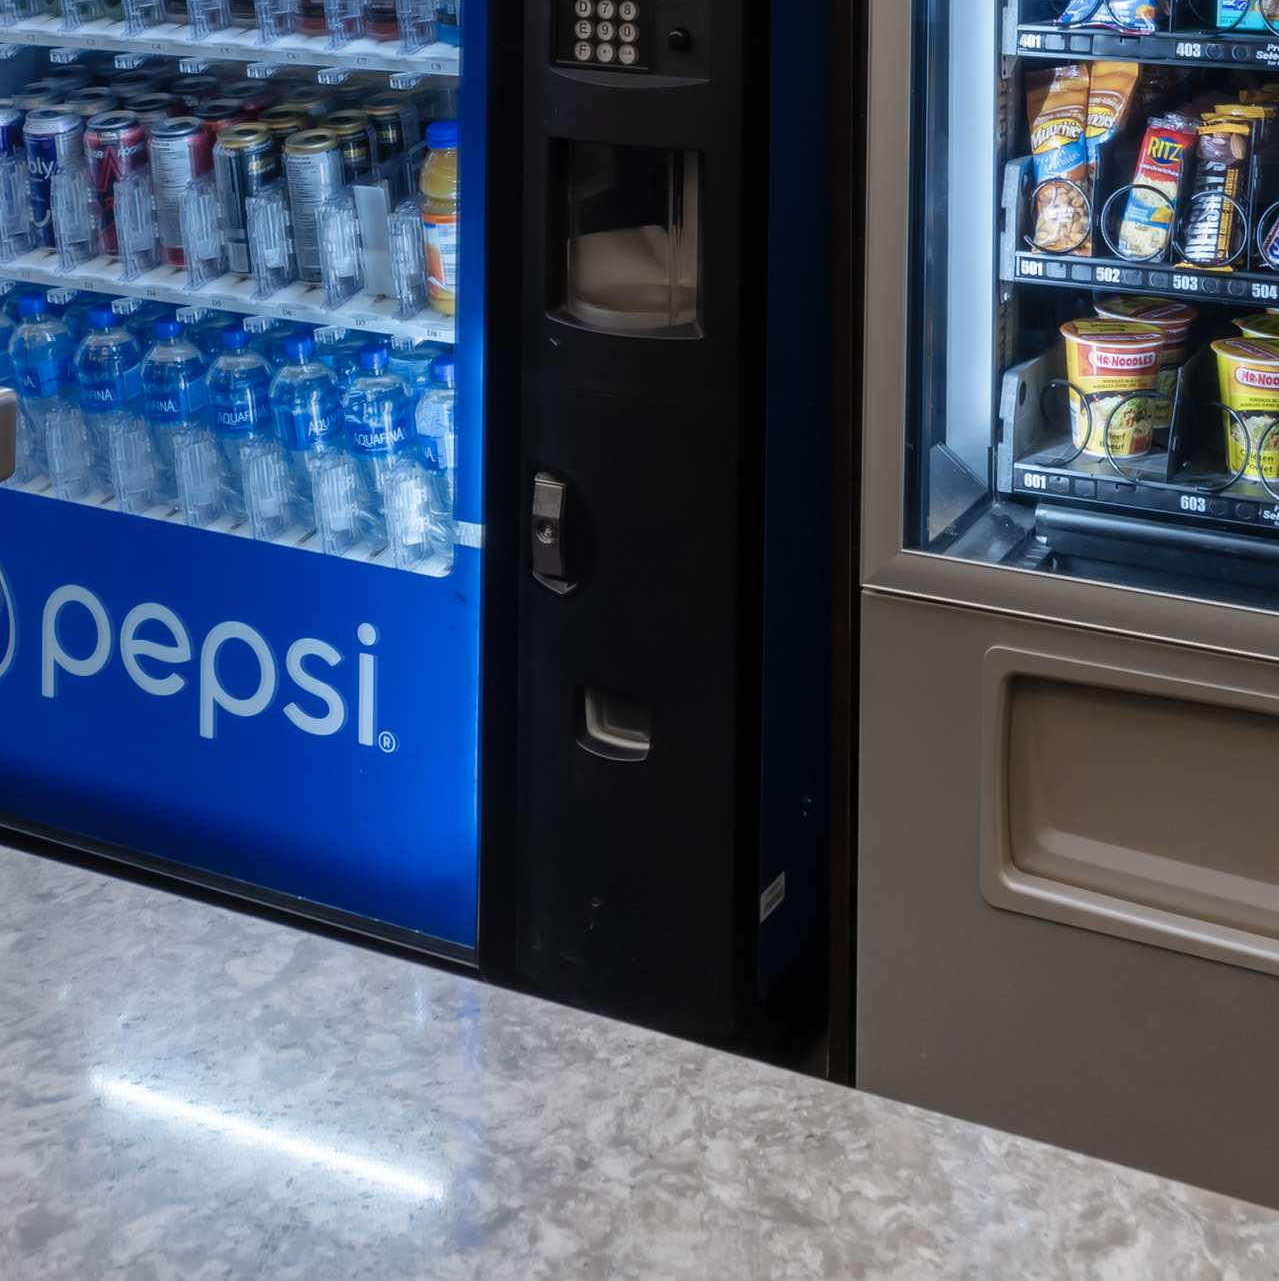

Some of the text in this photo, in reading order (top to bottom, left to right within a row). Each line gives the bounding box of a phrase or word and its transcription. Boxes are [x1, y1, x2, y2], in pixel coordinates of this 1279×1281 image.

[579, 1, 631, 15] D 7 8
[580, 23, 631, 37] E 9 0
[1019, 34, 1042, 49] 401
[579, 44, 587, 55] F
[1176, 43, 1201, 57] 403
[1147, 136, 1184, 162] RITZ
[1021, 261, 1043, 276] 501
[1096, 268, 1120, 282] 502
[1173, 276, 1198, 291] 503
[1251, 284, 1278, 300] 504
[1023, 474, 1046, 489] 601
[1180, 495, 1206, 512] 603
[40, 584, 376, 747] pepsi
